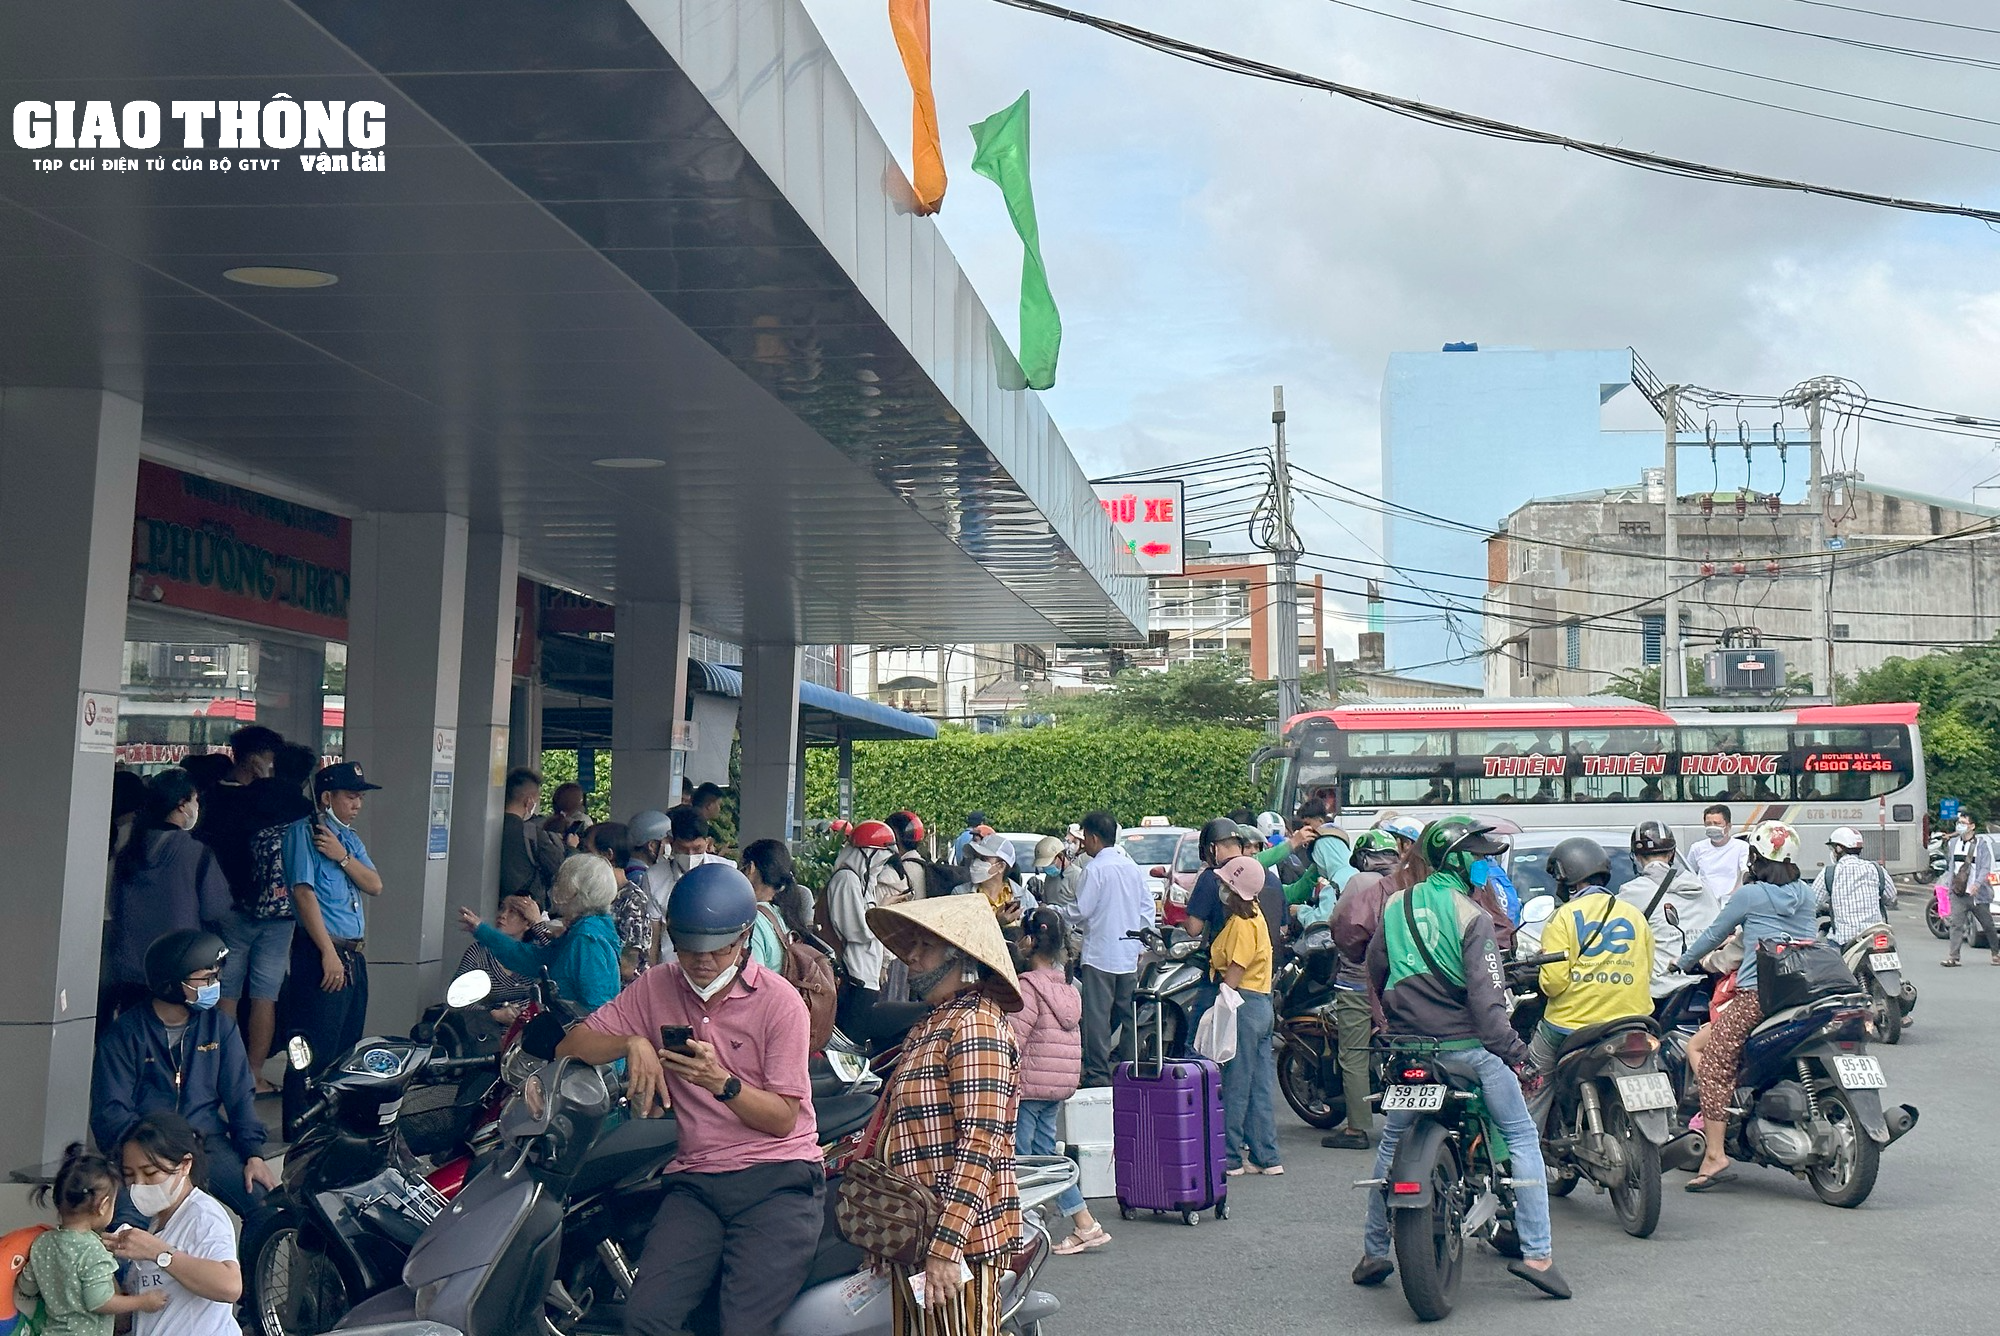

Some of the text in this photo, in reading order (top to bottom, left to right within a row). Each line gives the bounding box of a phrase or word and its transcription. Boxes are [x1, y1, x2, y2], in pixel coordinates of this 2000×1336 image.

[1143, 498, 1174, 522] XE
[1483, 751, 1783, 777] THIÊN THIÊN HƯƠNG
[1814, 760, 1892, 771] 1900 4646
[1573, 909, 1635, 957] be
[1485, 953, 1502, 989] gojek
